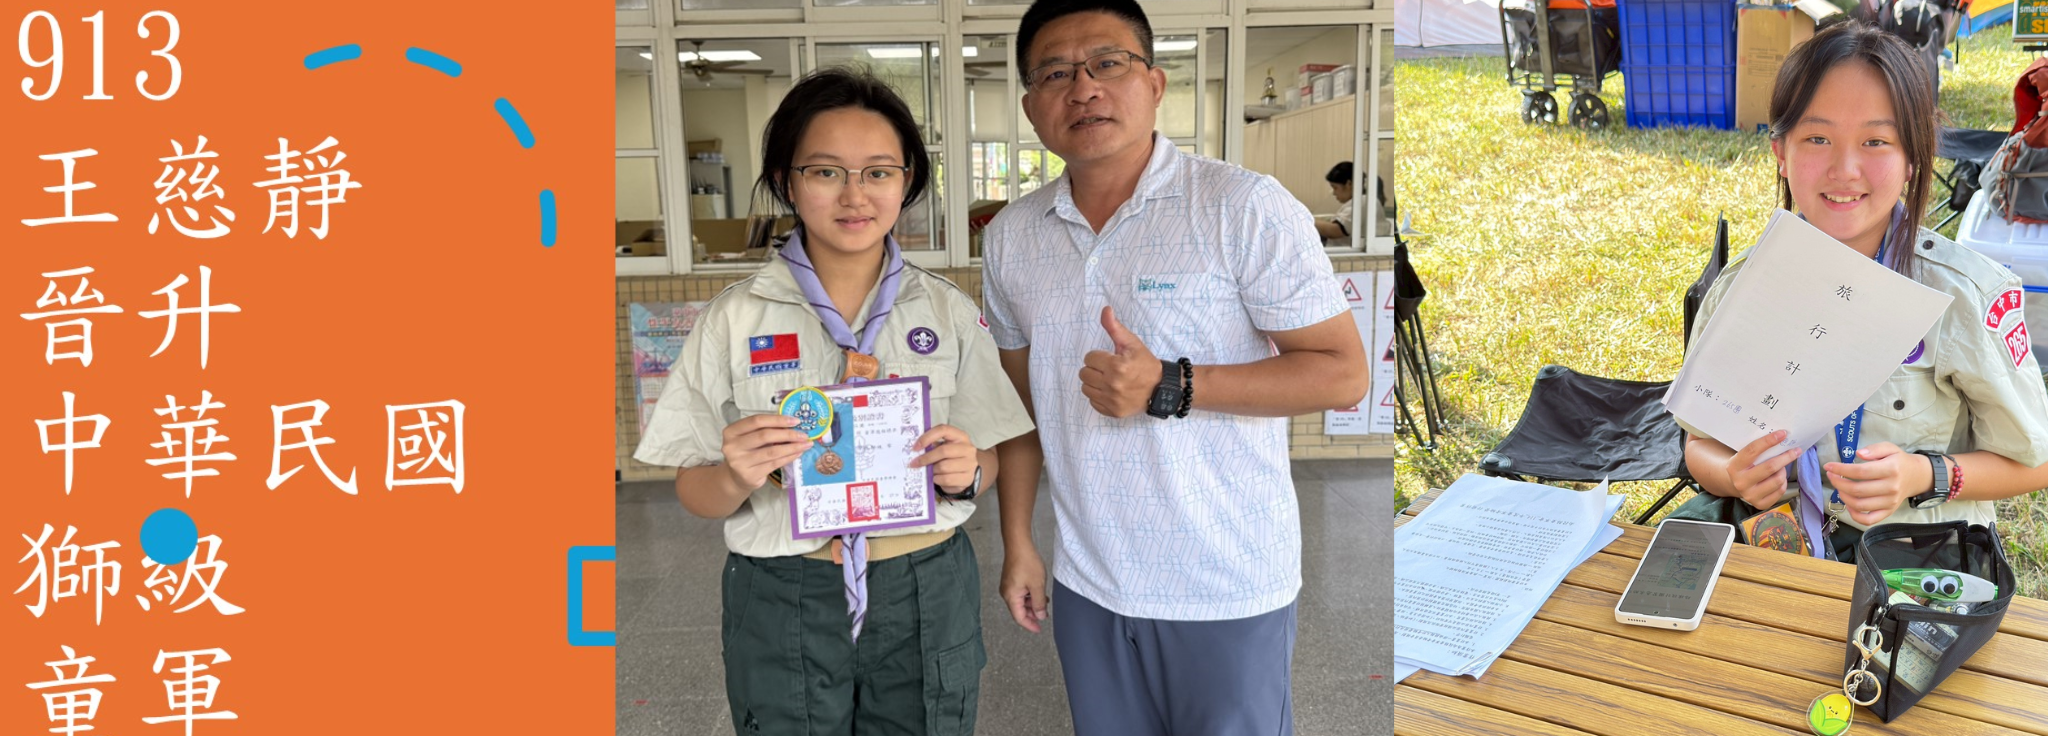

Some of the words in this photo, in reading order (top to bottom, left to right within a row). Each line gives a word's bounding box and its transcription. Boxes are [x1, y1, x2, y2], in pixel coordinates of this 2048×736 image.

[1152, 280, 1176, 292] Lynx
[1988, 290, 2018, 325] 台中市
[1760, 284, 1854, 410] 旅行計劃
[2008, 325, 2027, 363] 265
[1851, 411, 1857, 420] OF
[1847, 420, 1856, 443] SCOUTS
